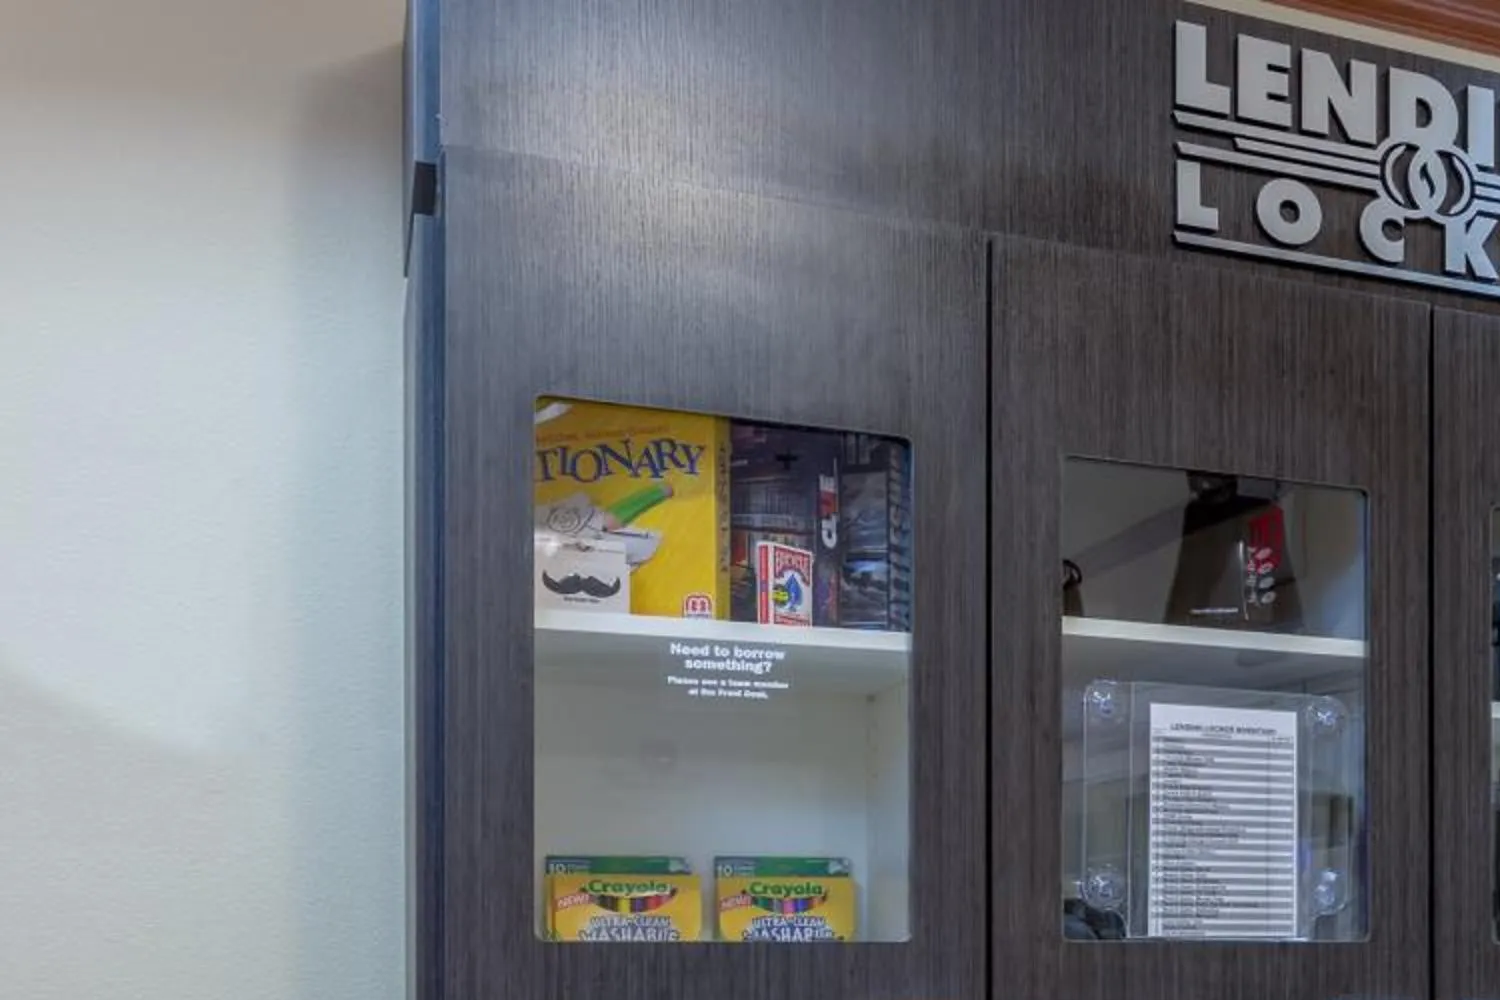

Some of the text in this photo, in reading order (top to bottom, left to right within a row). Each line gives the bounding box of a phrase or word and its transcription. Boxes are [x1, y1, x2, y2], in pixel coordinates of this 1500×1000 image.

[536, 437, 706, 483] TIONARY
[670, 642, 785, 661] Need to borrow
[684, 658, 773, 674] something?
[717, 864, 733, 876] 10
[588, 879, 667, 896] Crayola
[749, 881, 823, 896] Crayola
